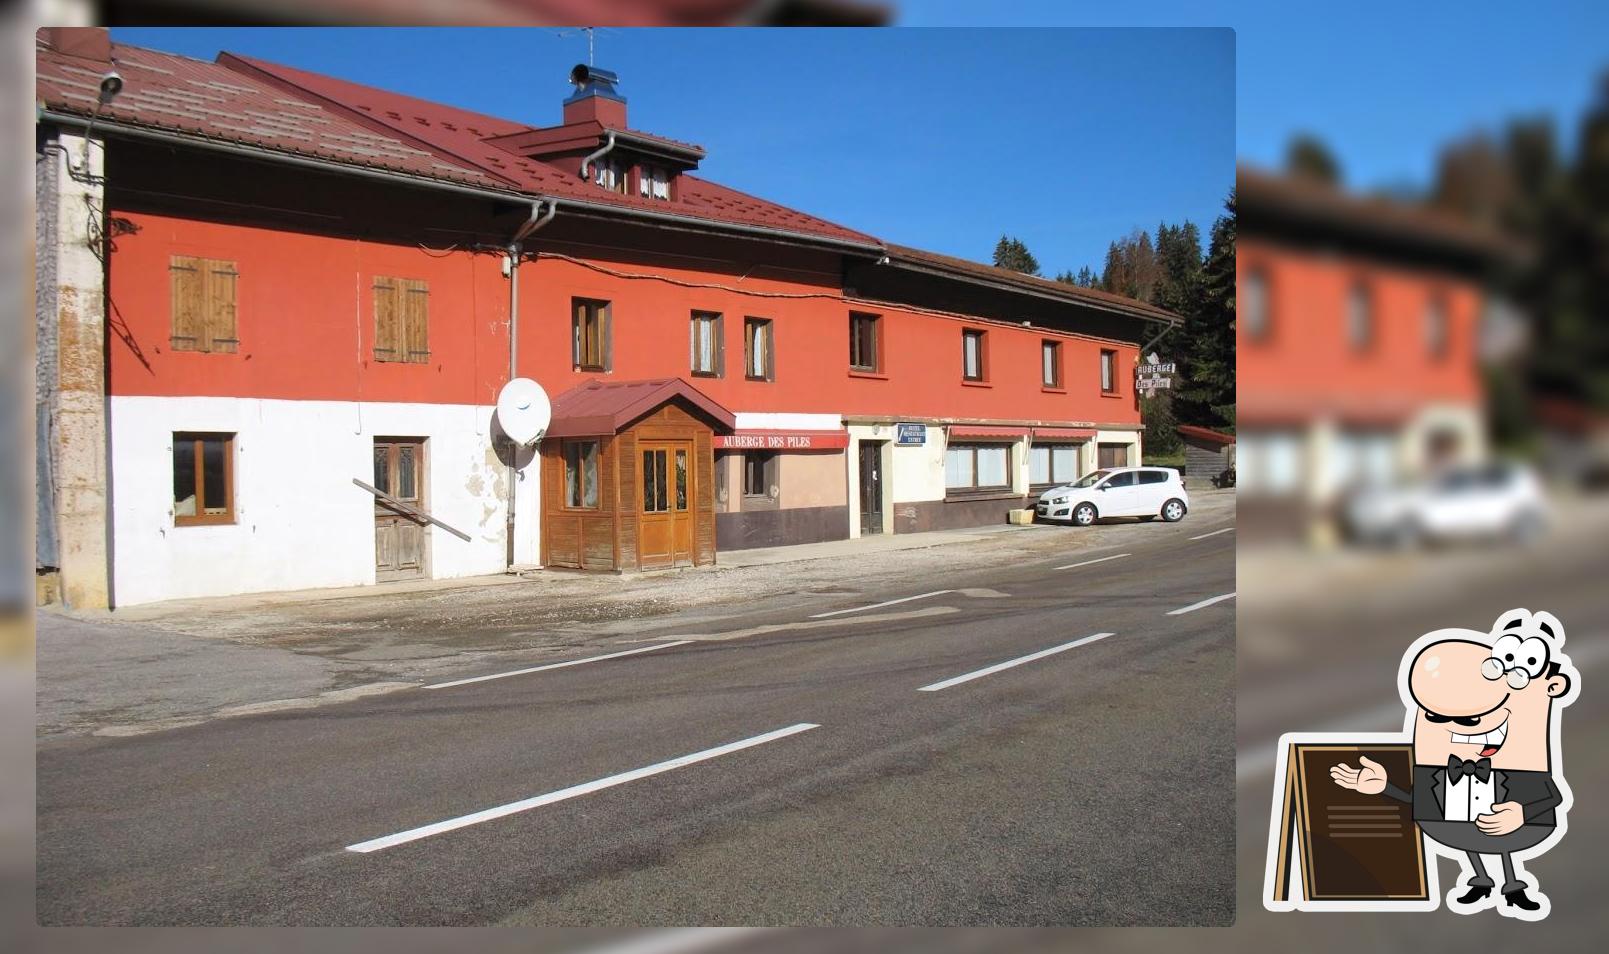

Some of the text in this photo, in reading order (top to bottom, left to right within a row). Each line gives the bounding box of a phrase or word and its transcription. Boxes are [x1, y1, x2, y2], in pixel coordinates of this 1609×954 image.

[1137, 364, 1171, 373] AUBERGE
[723, 436, 811, 448] AUBERGE DES PILES
